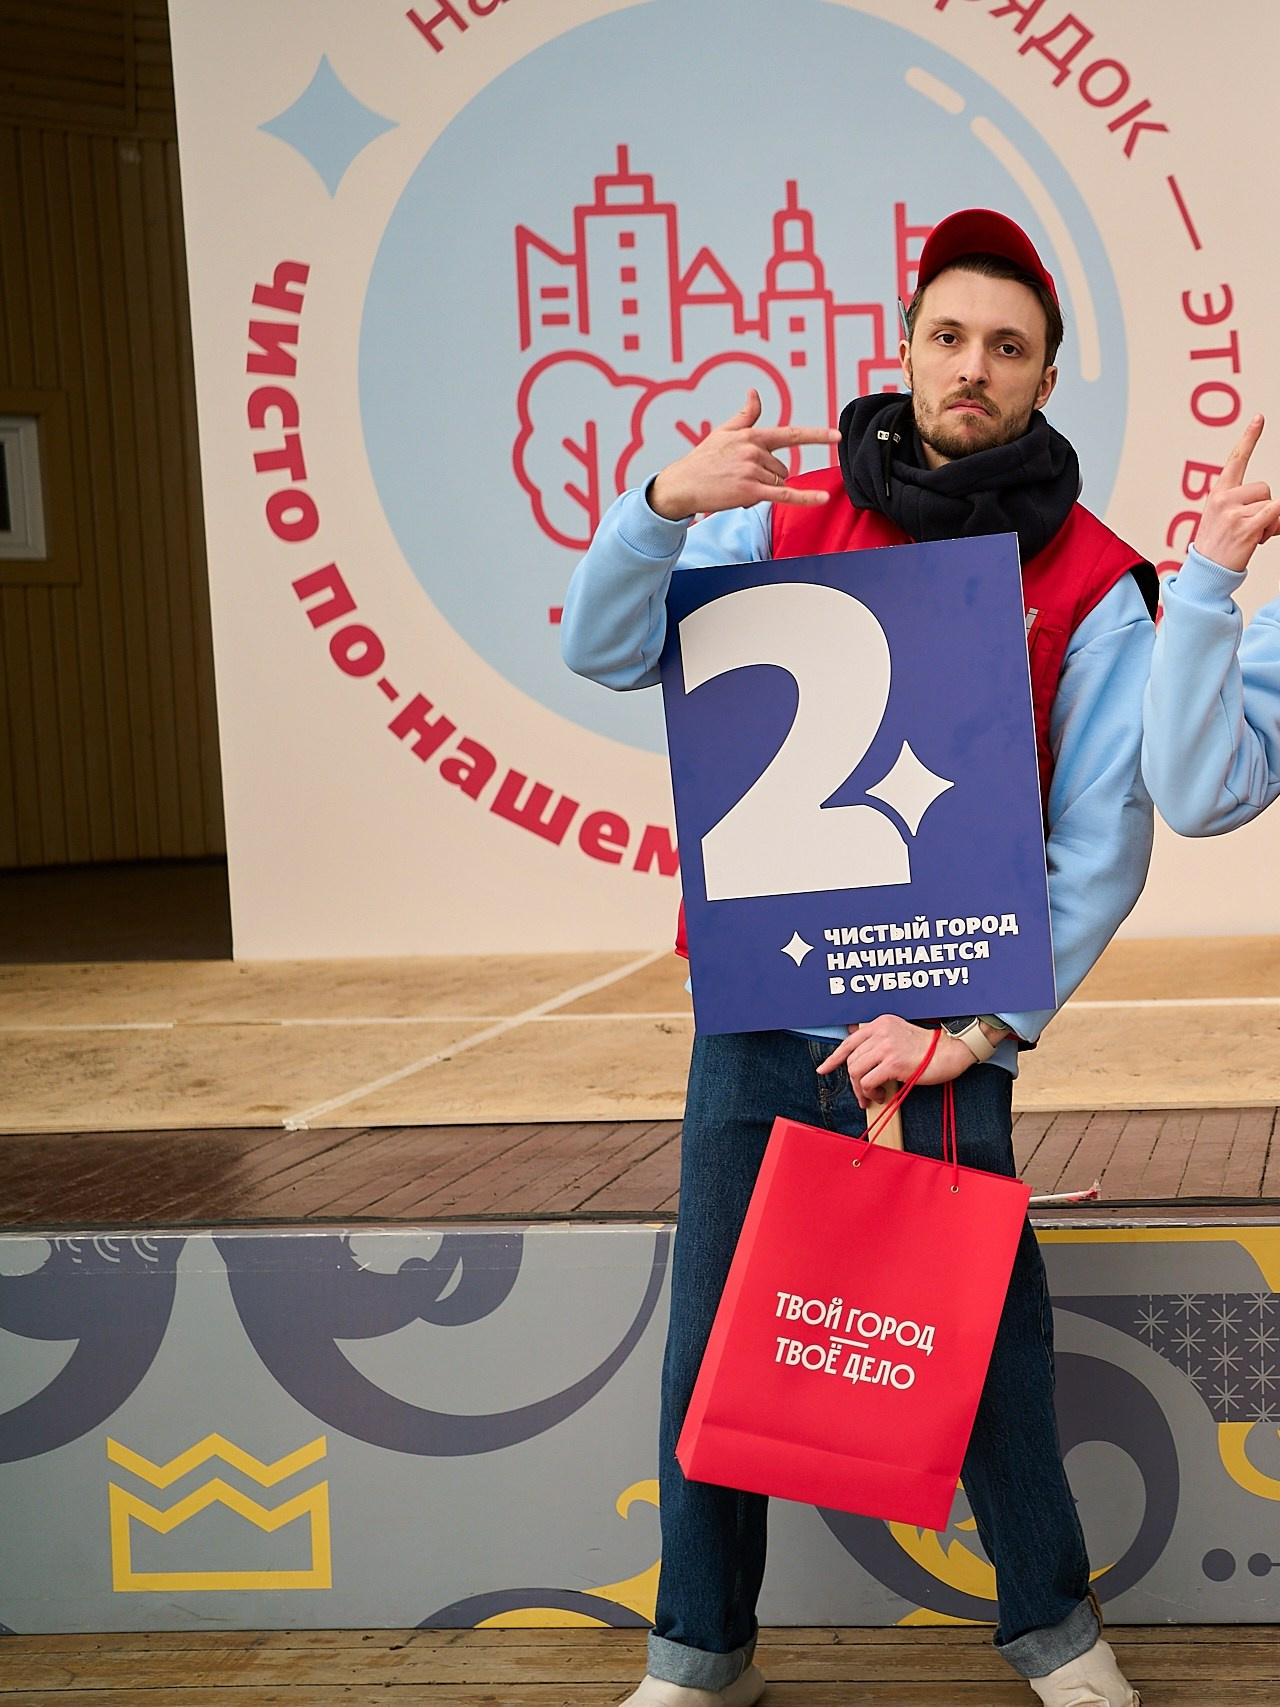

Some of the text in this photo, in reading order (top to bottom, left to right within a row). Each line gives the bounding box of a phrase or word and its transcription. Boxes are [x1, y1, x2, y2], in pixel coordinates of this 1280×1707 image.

[934, 0, 1170, 160] ядок
[1182, 283, 1241, 427] это
[247, 260, 681, 878] чисто по-нашем
[678, 582, 911, 901] 2
[823, 913, 1020, 946] ЧИСТЫЙ ГОРОД
[826, 940, 991, 971] НАЧИНАЕТСЯ
[829, 967, 970, 995] В СУББОТУ!
[775, 1291, 936, 1356] ТВОЙ ГОРОД
[775, 1336, 915, 1390] ТВОЁ ДЕЛО
